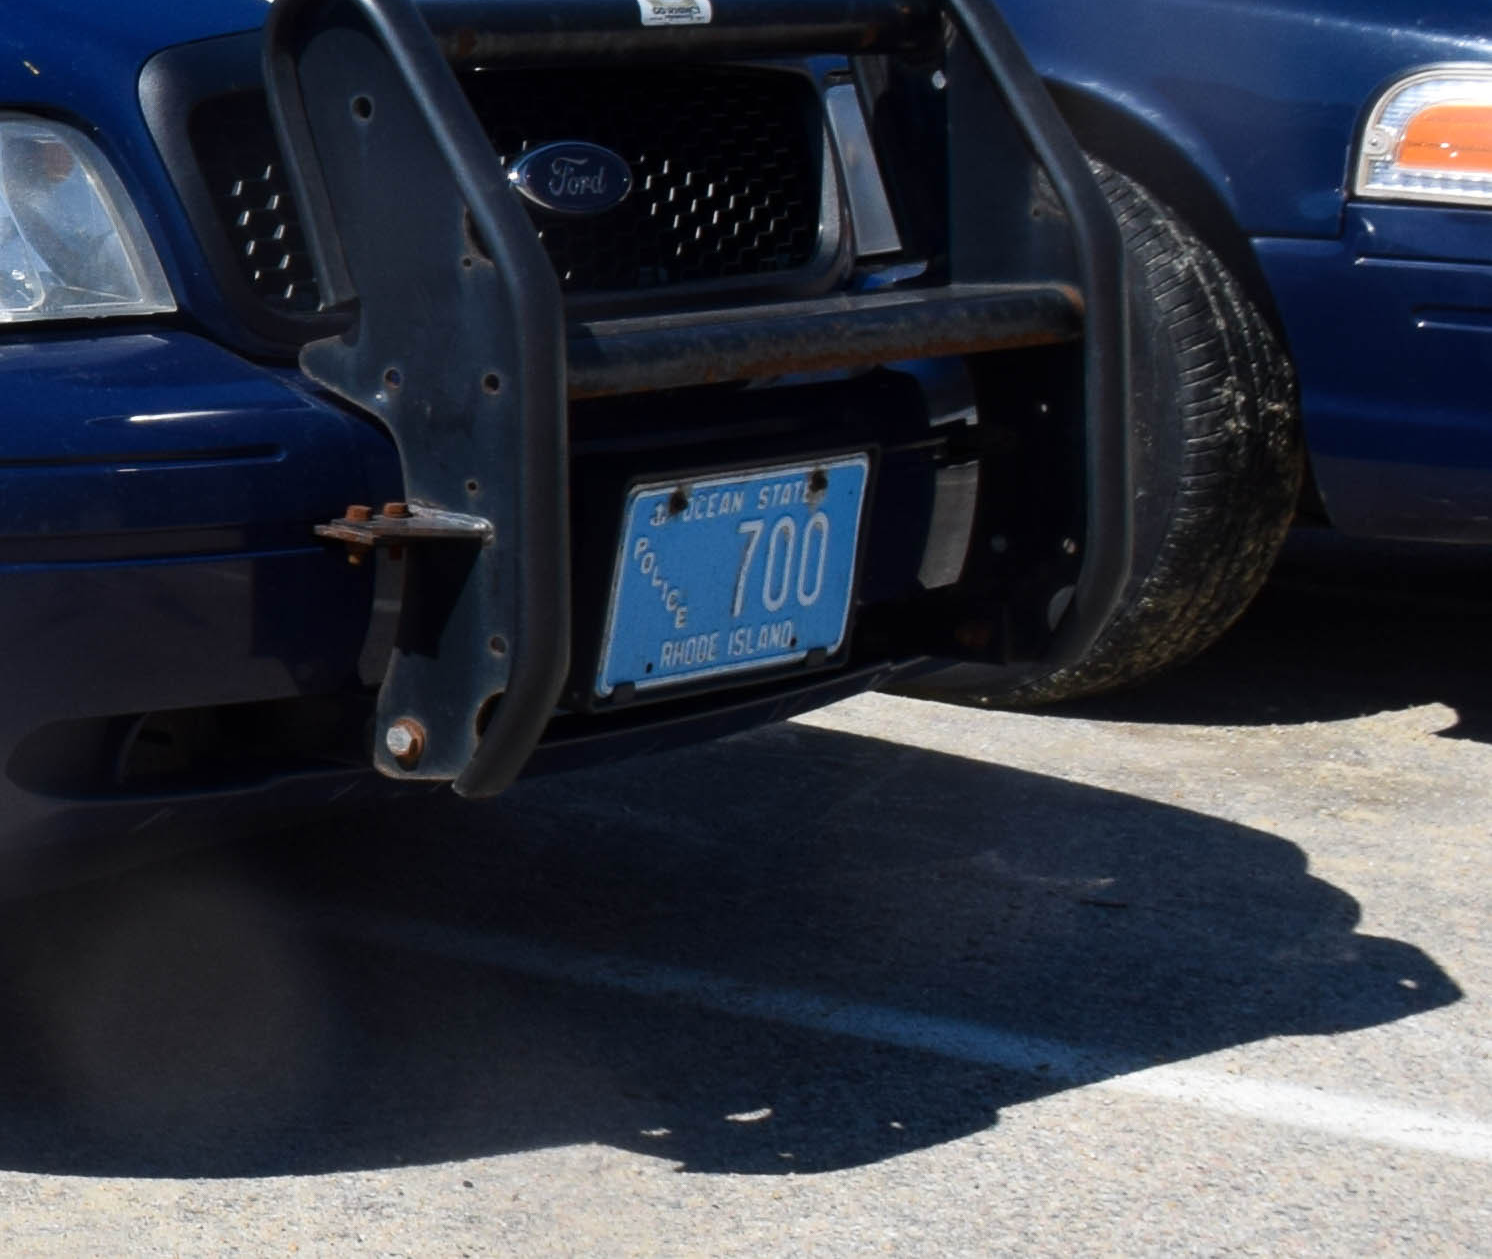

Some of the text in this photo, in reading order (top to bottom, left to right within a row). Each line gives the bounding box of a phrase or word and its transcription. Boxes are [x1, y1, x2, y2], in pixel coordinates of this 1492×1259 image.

[548, 157, 607, 197] Ford
[682, 491, 745, 523] OCEAN
[634, 536, 688, 629] POLICE
[732, 511, 829, 618] 700
[659, 619, 794, 669] RHODE ISLAND
